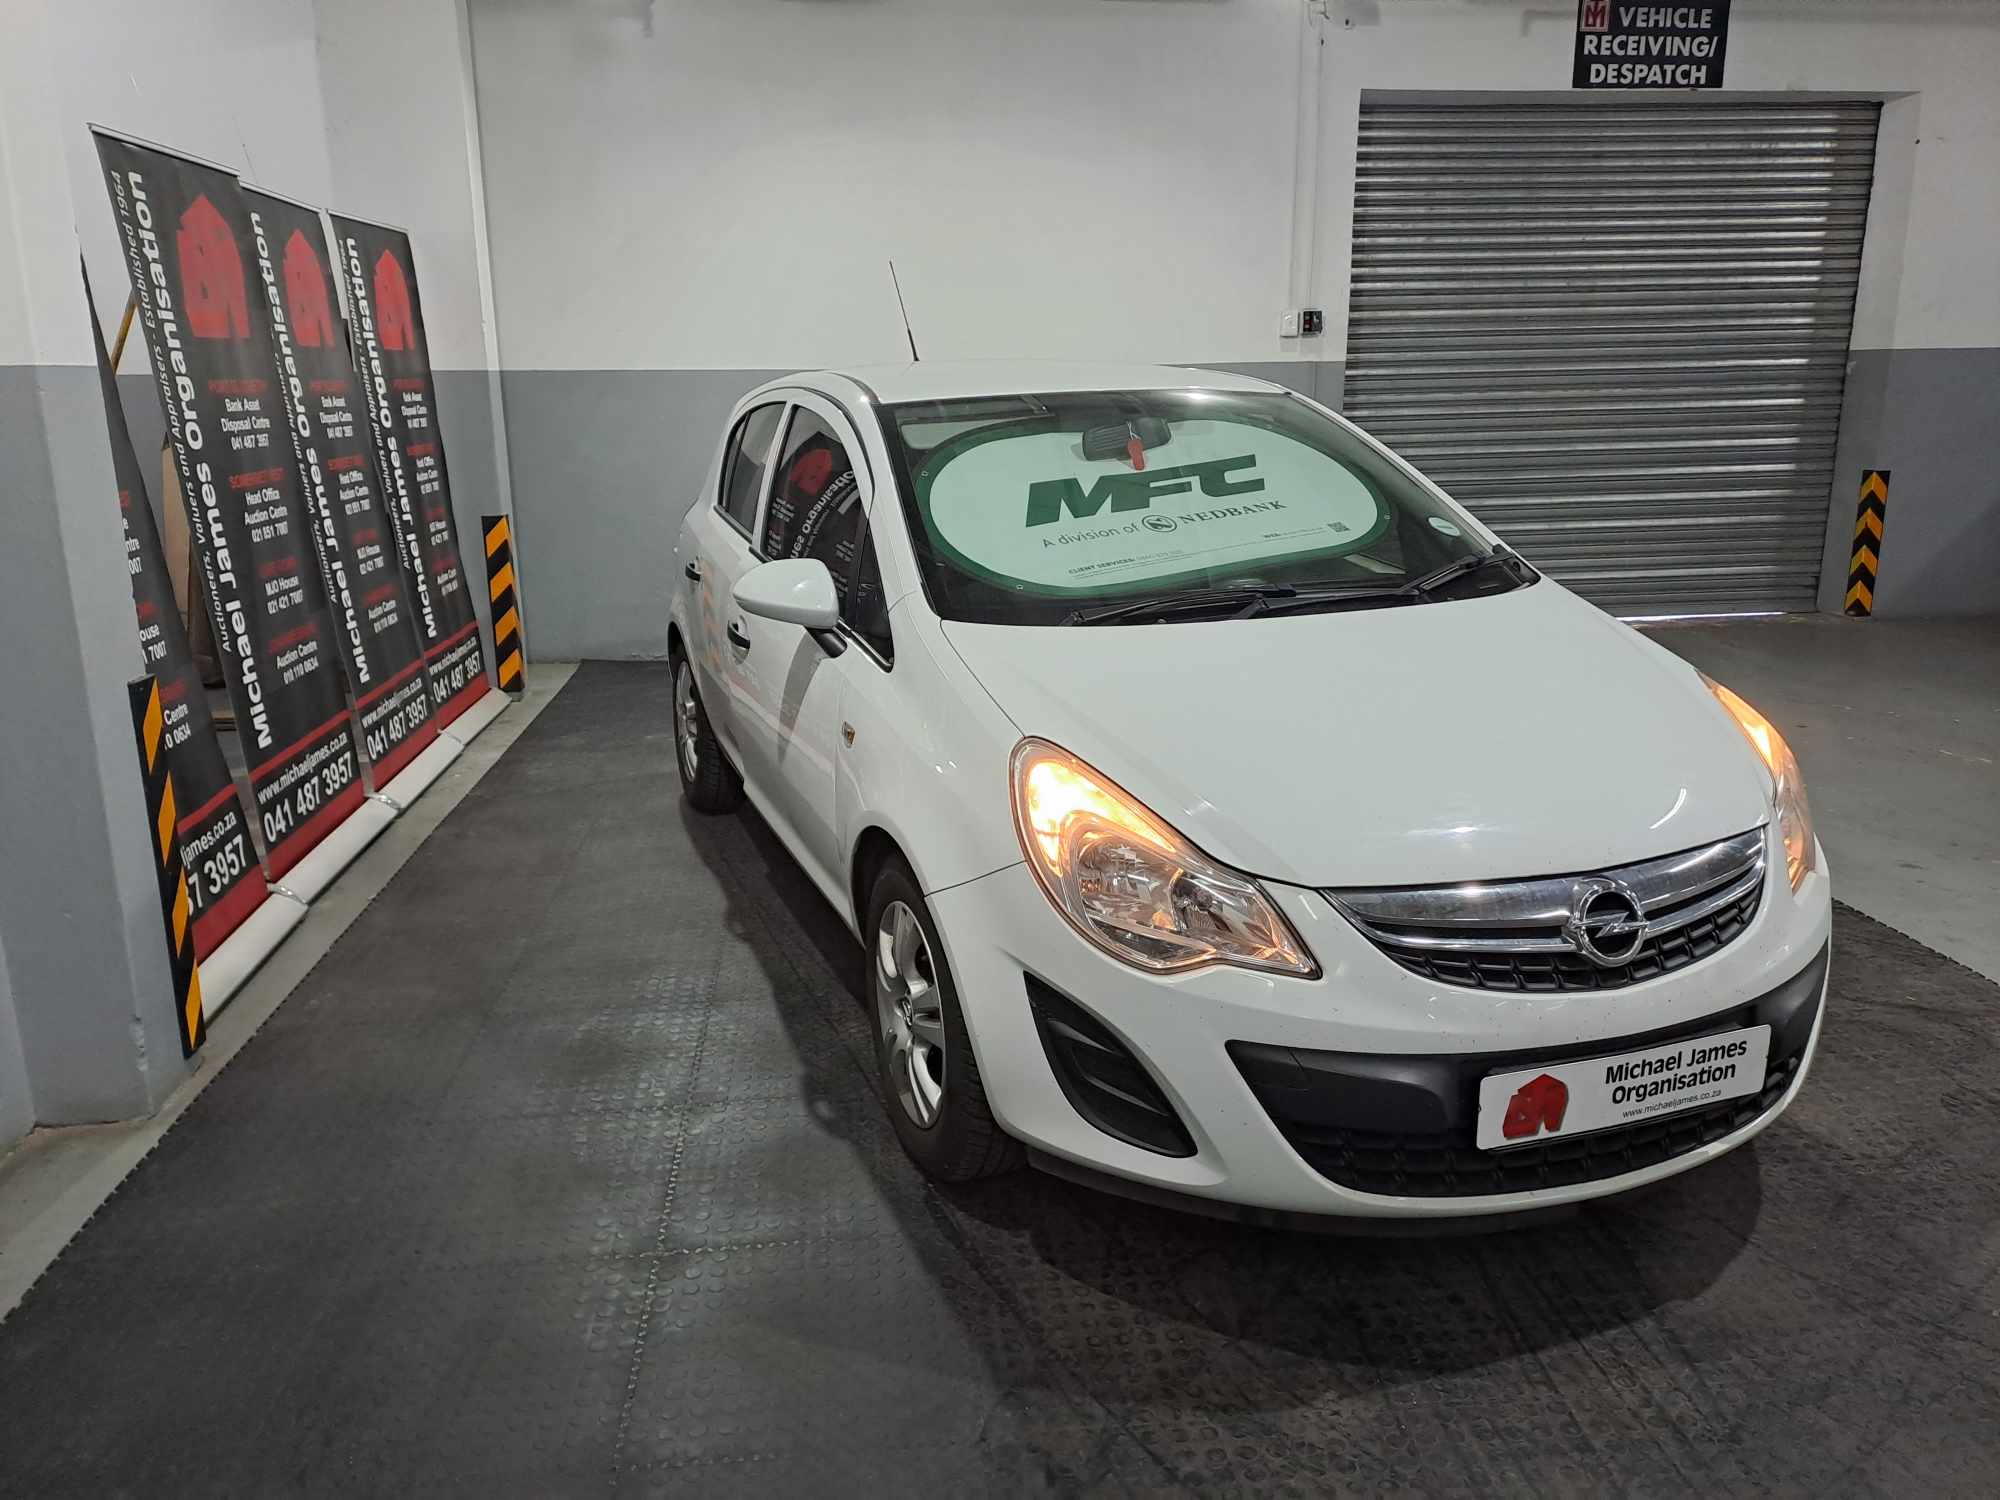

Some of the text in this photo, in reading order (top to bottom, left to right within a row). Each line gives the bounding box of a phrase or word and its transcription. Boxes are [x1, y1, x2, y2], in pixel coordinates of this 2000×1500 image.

[1619, 7, 1713, 29] VEHICLE
[1583, 34, 1719, 57] RECEIVING/
[1589, 63, 1708, 85] DESPATCH
[110, 170, 130, 217] 1964
[122, 222, 156, 329] Established
[250, 211, 311, 438] Organisation
[346, 237, 393, 429] Organisation
[153, 345, 183, 439] Appraisers
[221, 417, 251, 433] Disposal
[231, 436, 243, 450] 041
[243, 435, 256, 449] 487
[128, 171, 273, 750] Michael James Organisation
[175, 442, 191, 477] and
[387, 436, 414, 526] James
[185, 482, 206, 543] Valuers
[306, 447, 339, 552] James
[1025, 454, 1266, 528] MFC
[1178, 499, 1288, 525] NEDBANK
[244, 511, 269, 526] Auction
[1041, 522, 1142, 548] A division of
[125, 536, 140, 552] ntre
[128, 556, 142, 575] 007
[203, 550, 232, 653] Auctioneers,
[406, 533, 437, 638] Michael
[140, 623, 160, 642] ouse
[331, 560, 370, 684] Michael
[148, 640, 167, 660] 7007
[276, 646, 299, 670] Auction
[433, 650, 481, 704] 041 487 3957
[164, 703, 189, 725] Centre
[173, 722, 192, 745] 0634
[366, 693, 428, 760] 041 487 3957
[257, 731, 348, 805] www.michaeljames.co.za
[263, 750, 354, 843] 041 487 3957
[180, 811, 237, 870] ljames.co.za
[203, 833, 247, 895] 3957
[1605, 1040, 1748, 1085] Michael James
[1612, 1063, 1736, 1105] Organisation
[1622, 1088, 1722, 1119] www.michaeljames.co.za
